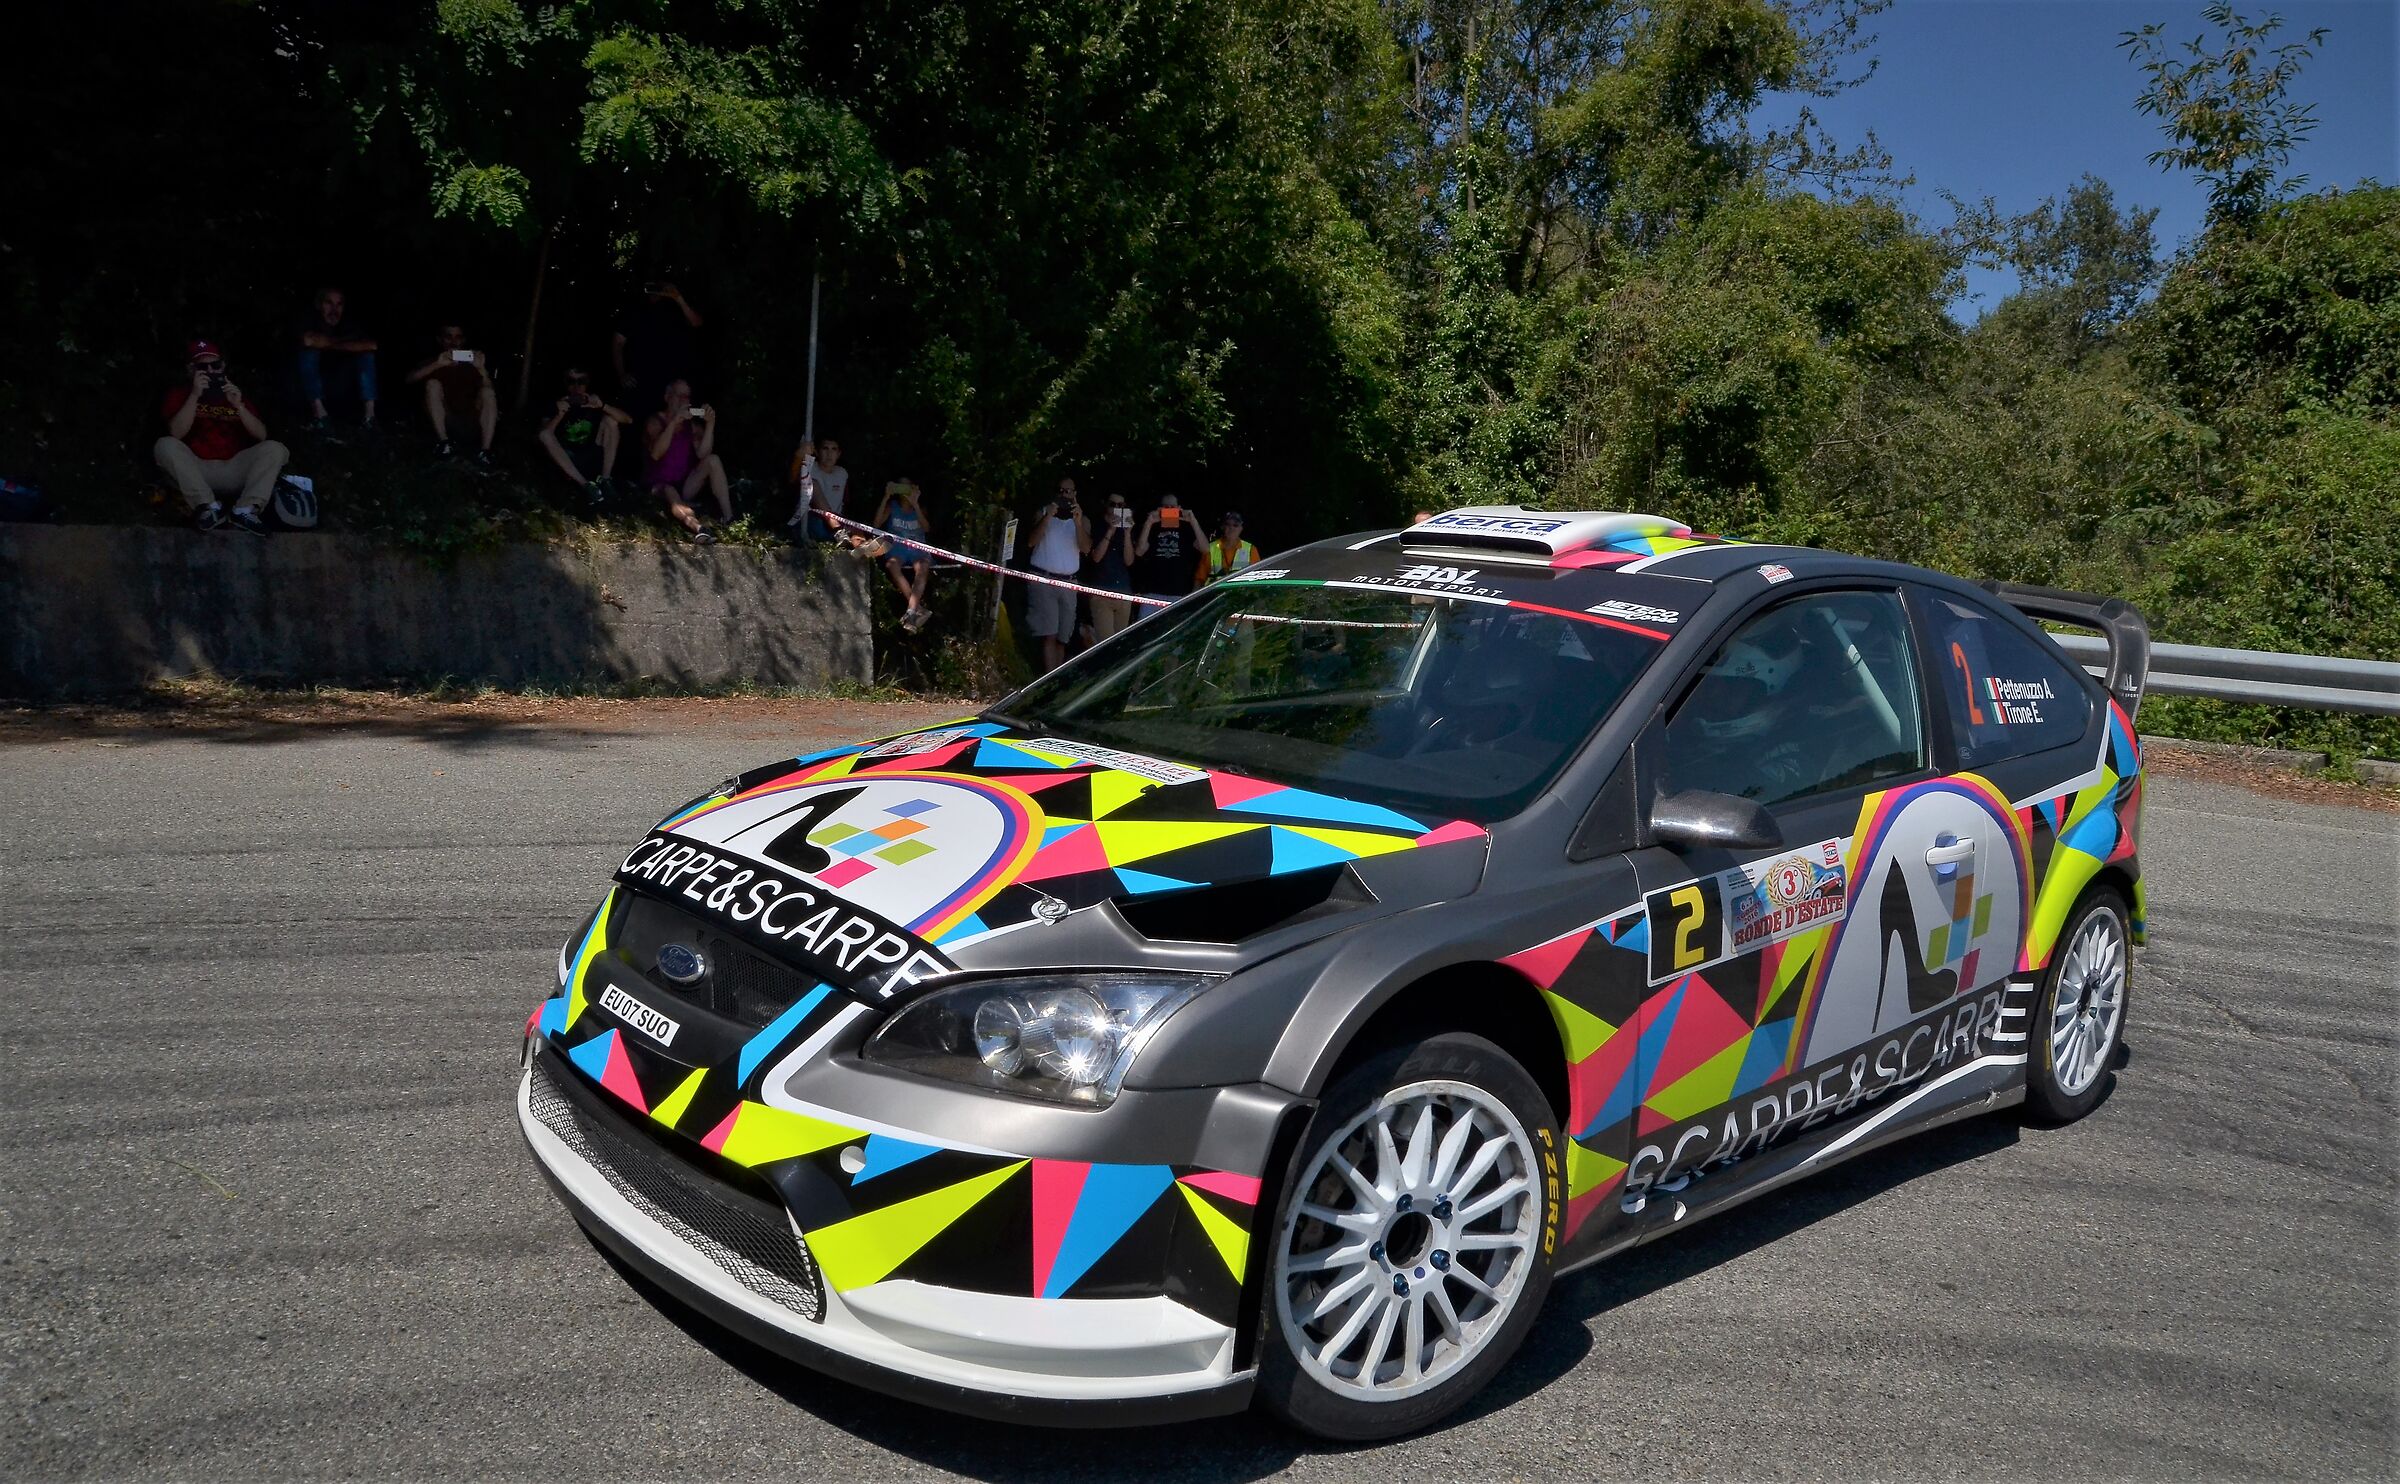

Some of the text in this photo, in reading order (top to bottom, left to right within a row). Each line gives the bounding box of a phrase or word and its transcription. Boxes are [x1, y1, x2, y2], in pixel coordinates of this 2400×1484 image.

[1427, 514, 1563, 533] berca
[1350, 575, 1503, 597] MOTOR SPORT
[1599, 599, 1680, 618] METECO
[1952, 642, 1985, 725] 2
[1995, 677, 2055, 700] Pettenuzzo A.
[2002, 701, 2044, 724] Tirone E.
[620, 836, 951, 999] CARPE&SCARPE
[1670, 886, 1705, 970] 2
[1734, 911, 1782, 946] RONDE
[1785, 897, 1844, 929] D'ESTATE
[604, 988, 670, 1040] EU 07 SUO
